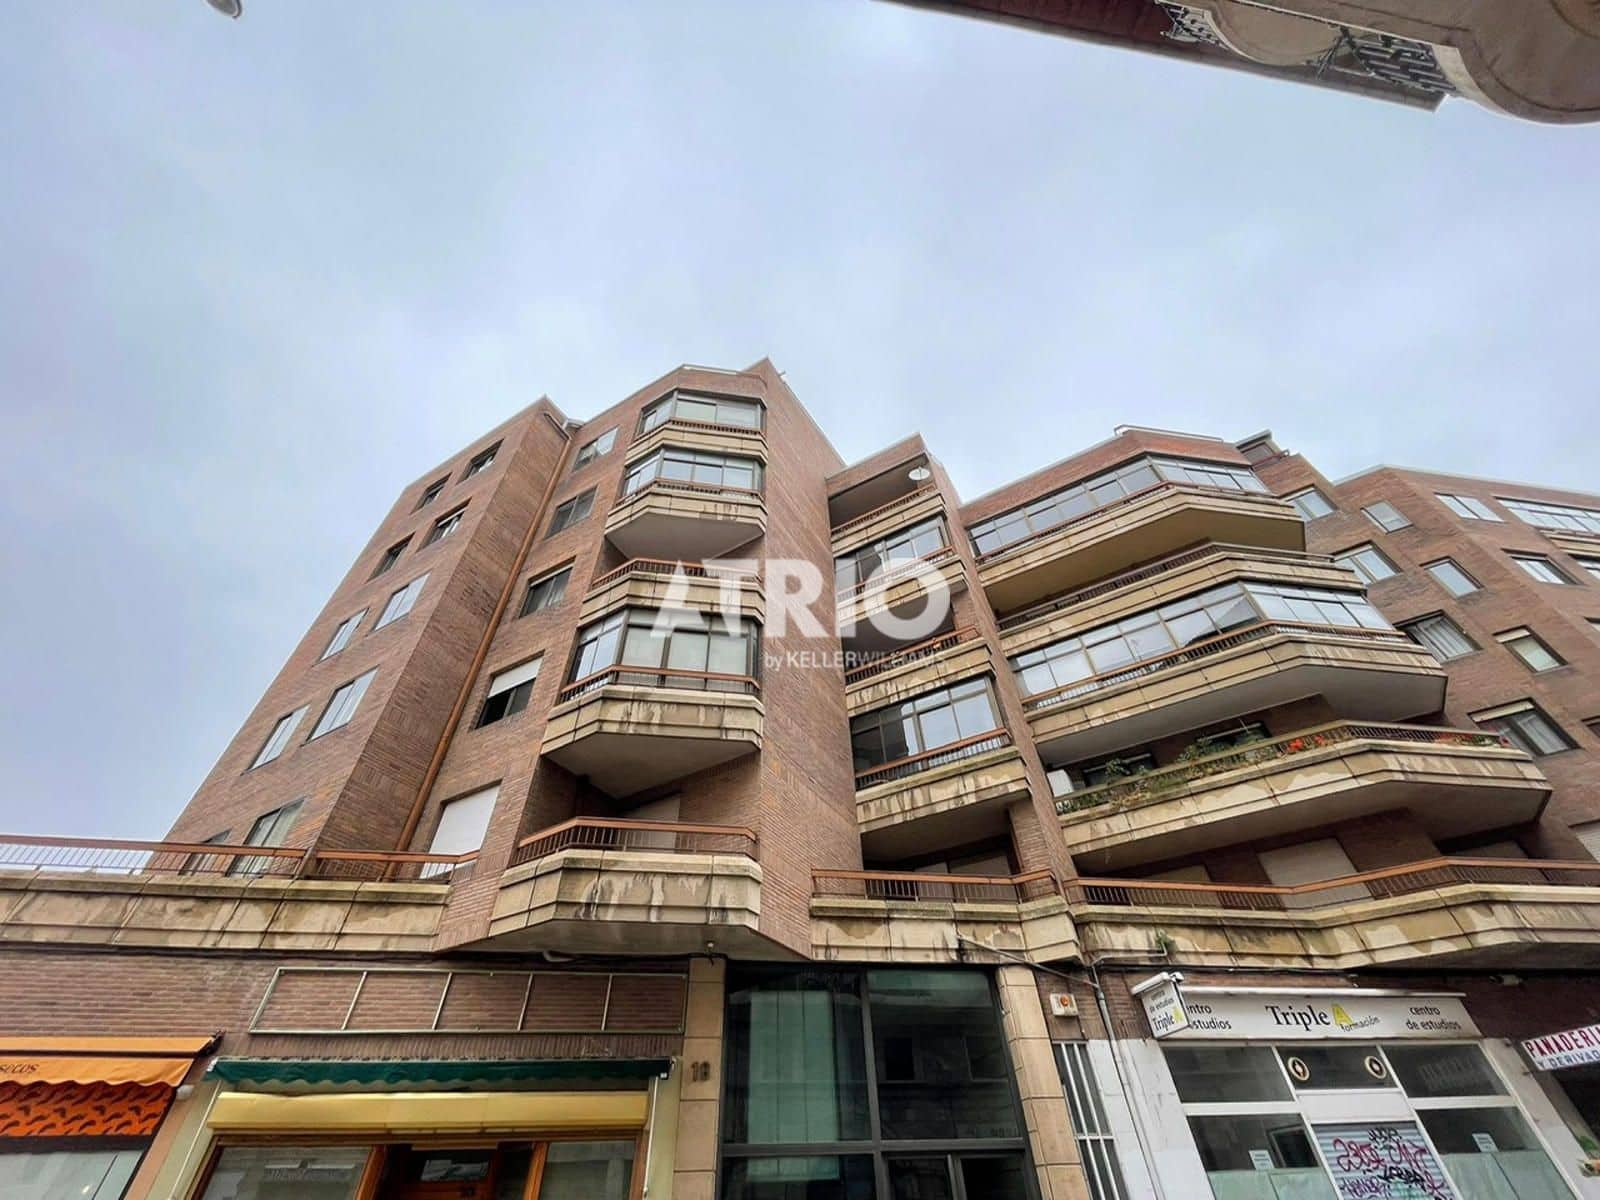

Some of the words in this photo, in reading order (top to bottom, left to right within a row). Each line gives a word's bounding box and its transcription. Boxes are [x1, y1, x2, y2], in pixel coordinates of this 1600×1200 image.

[1186, 1003, 1213, 1015] ntro
[1409, 1005, 1441, 1016] centro
[1265, 1004, 1331, 1032] Triple
[1405, 1019, 1418, 1031] de
[1421, 1019, 1462, 1031] estudios
